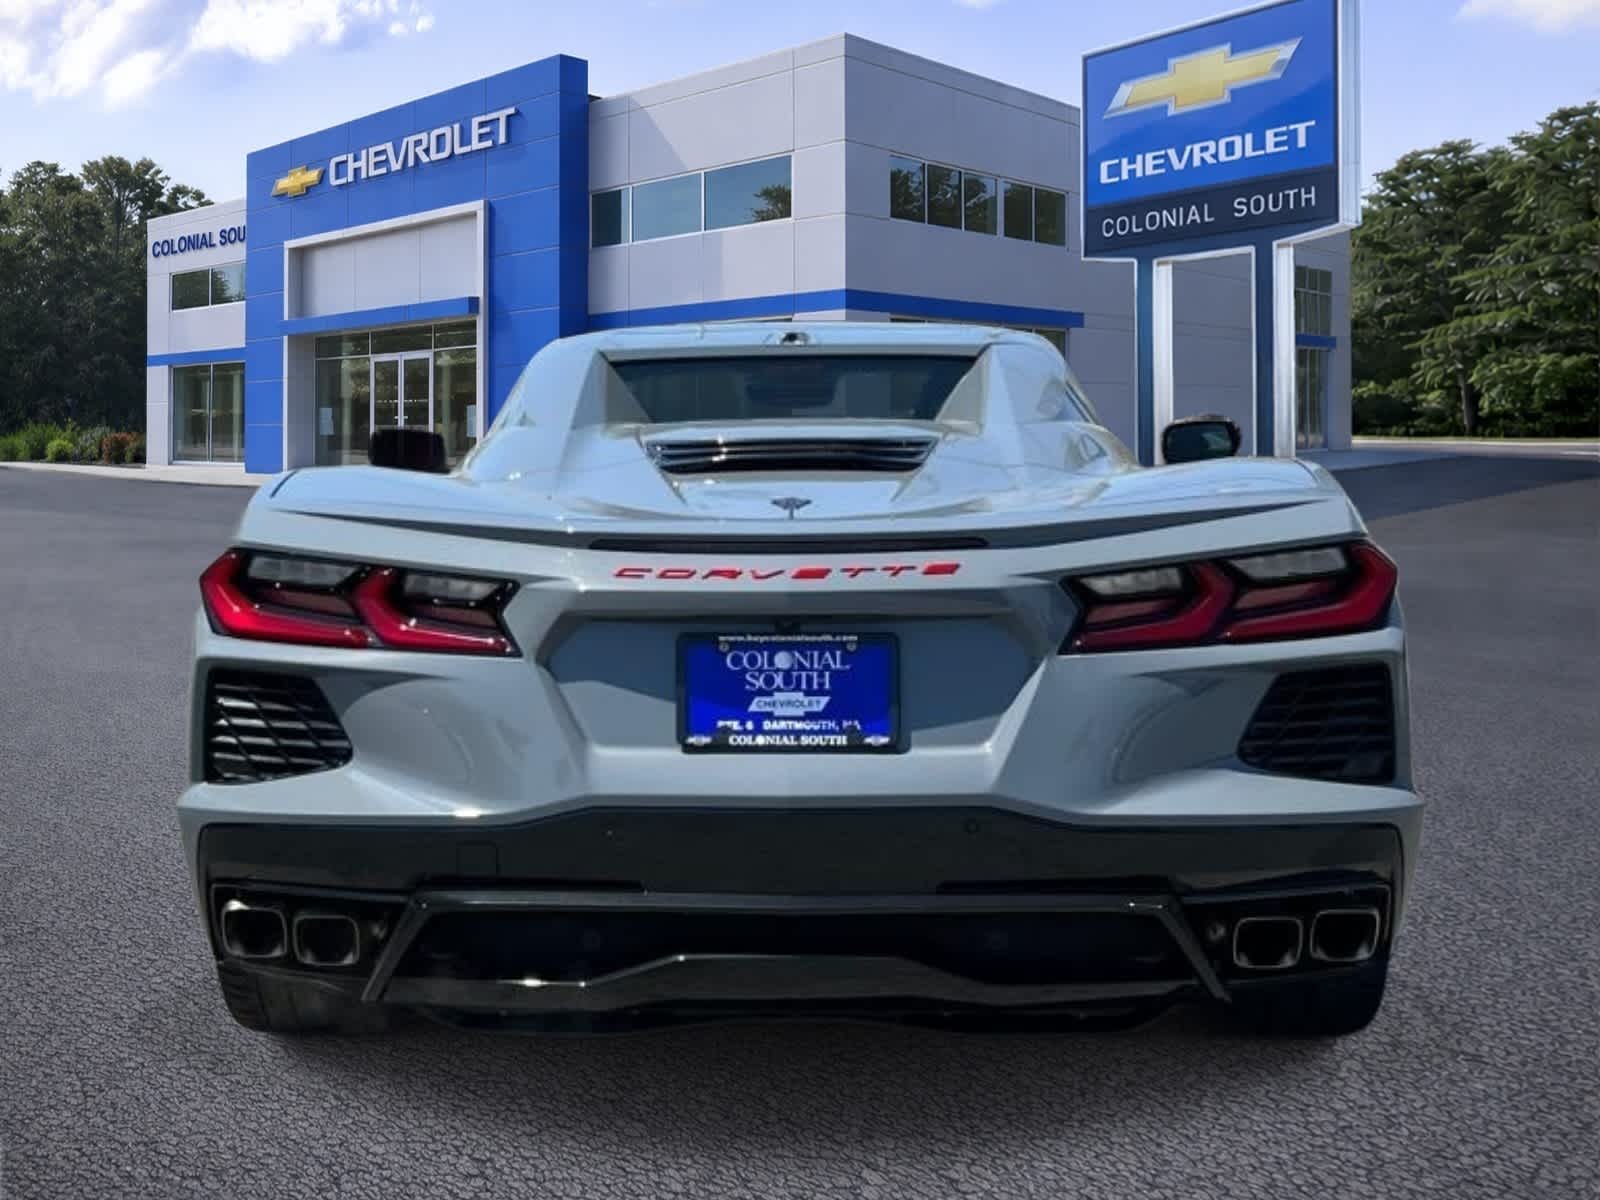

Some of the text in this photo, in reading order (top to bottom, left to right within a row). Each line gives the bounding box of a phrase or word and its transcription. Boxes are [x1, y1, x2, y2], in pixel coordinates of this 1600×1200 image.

[328, 106, 521, 187] CHEVROLET
[1099, 119, 1316, 184] CHEVROLET
[1102, 186, 1316, 238] COLONIAL SOUTH
[152, 225, 246, 258] COLONIAL SOU
[614, 563, 961, 580] CORVETTE
[726, 651, 850, 670] COLONIAL
[745, 671, 830, 691] SOUTH
[756, 699, 822, 709] CHEVROLET
[728, 735, 848, 745] COLONIAL SOUTH
